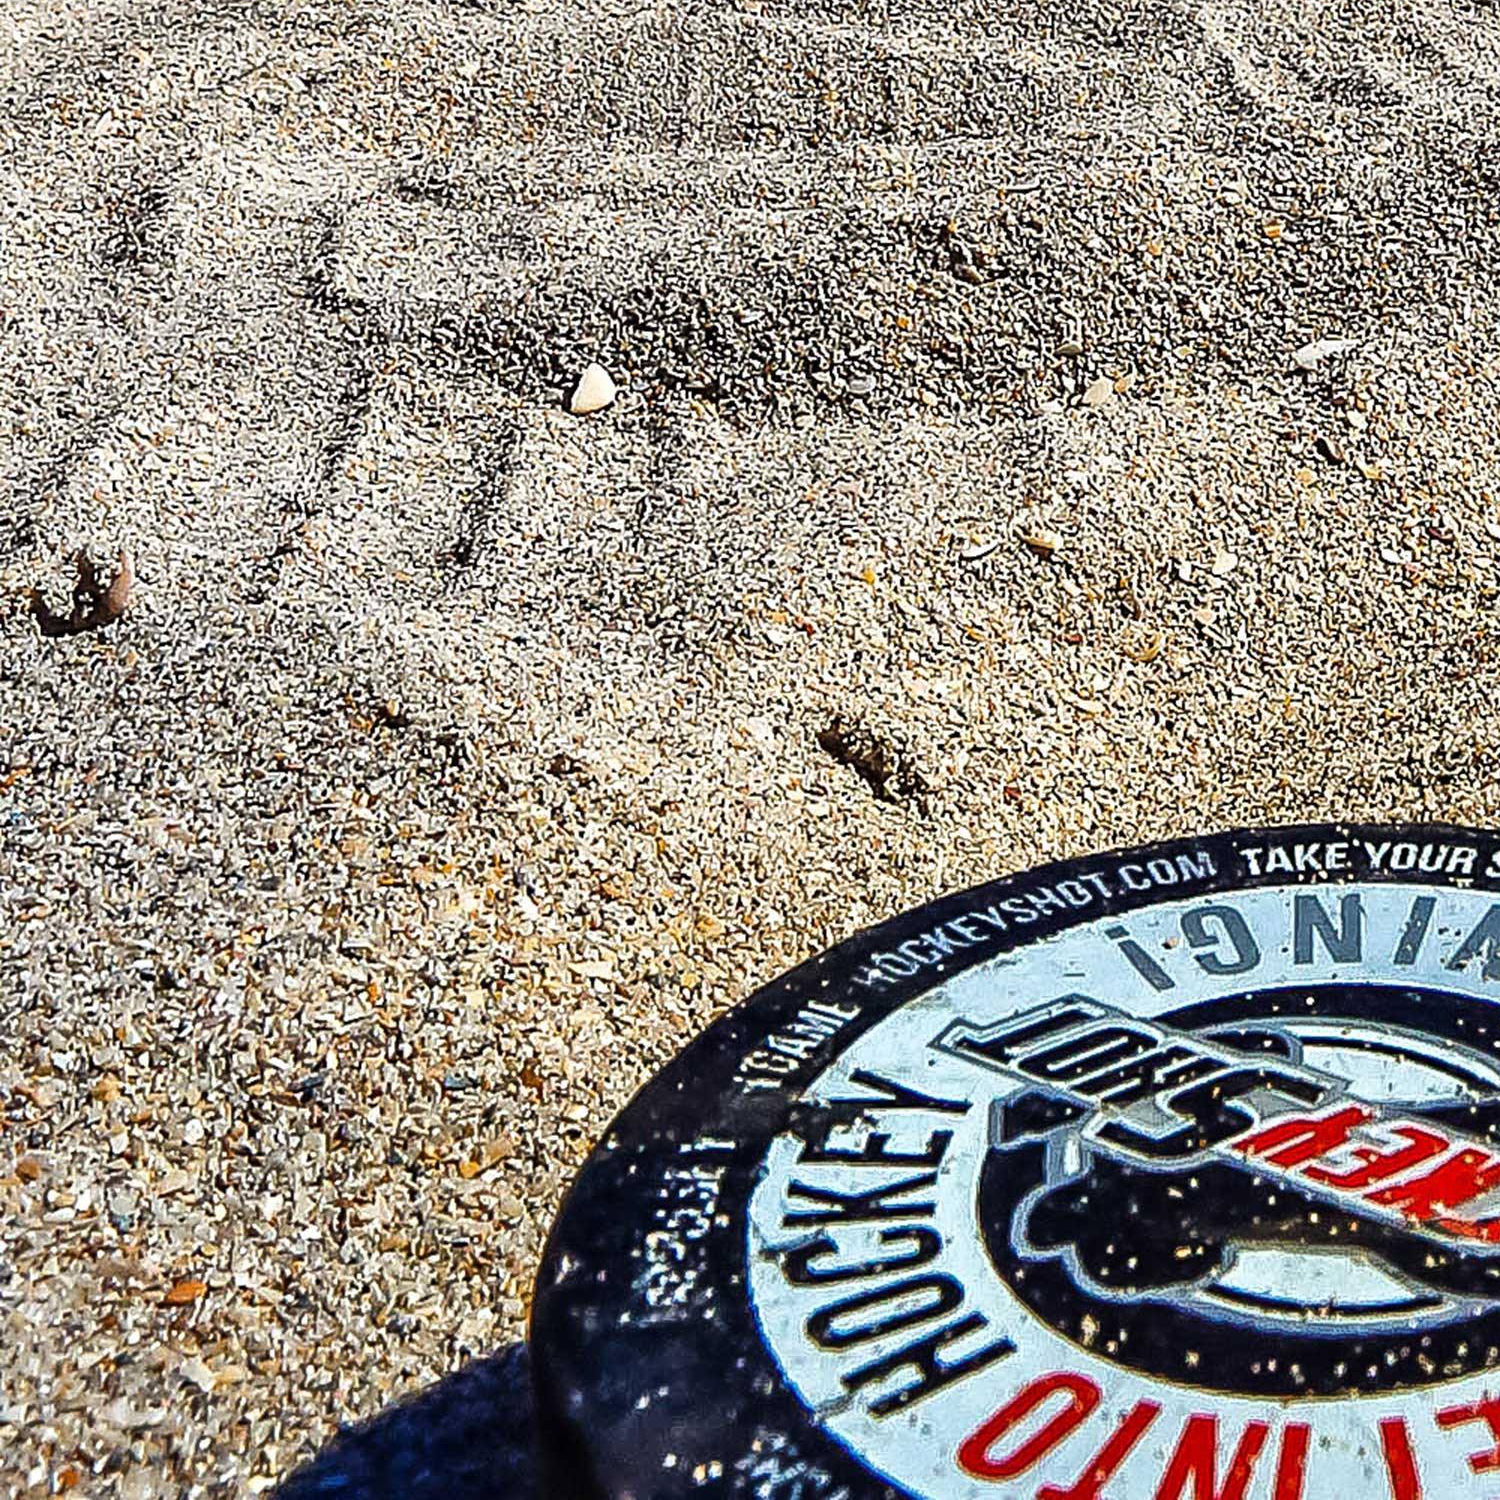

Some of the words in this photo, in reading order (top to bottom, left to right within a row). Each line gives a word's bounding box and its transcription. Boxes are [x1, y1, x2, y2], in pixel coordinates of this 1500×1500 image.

[1240, 841, 1348, 877] TAKE
[1364, 841, 1477, 875] YOUR
[780, 1069, 1018, 1418] HOCKEY
[955, 1372, 1312, 1500] INTO
